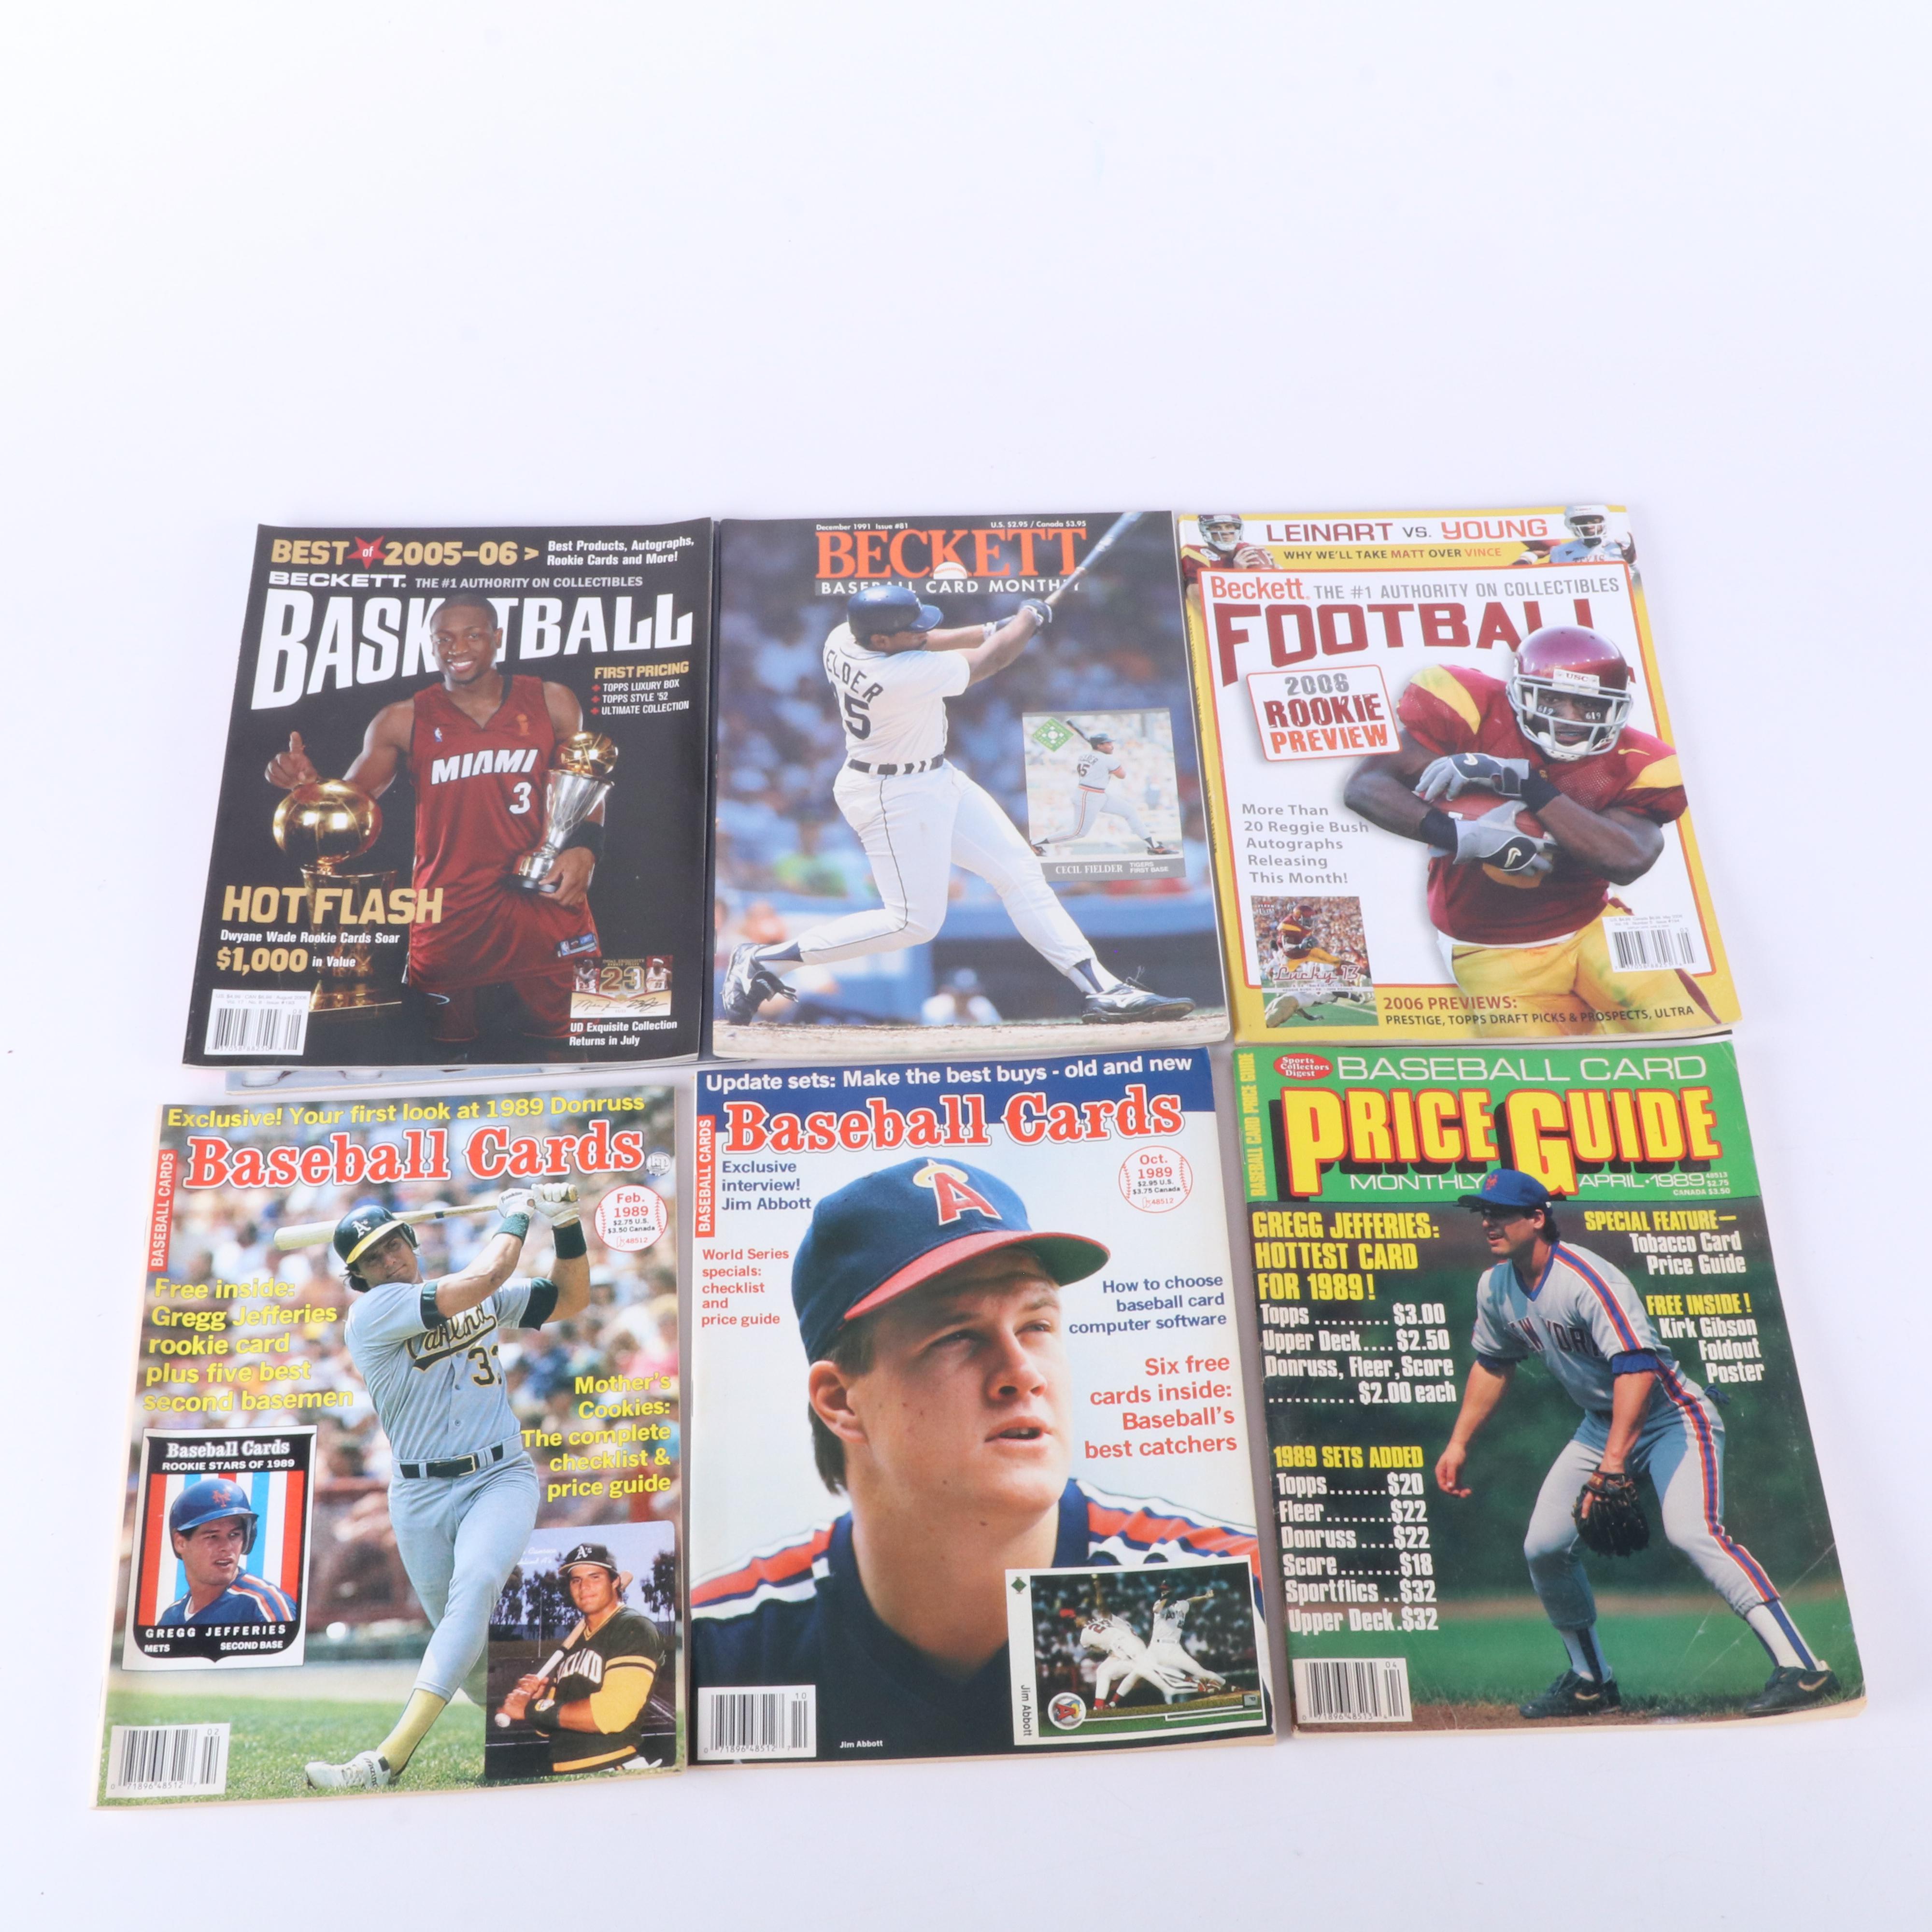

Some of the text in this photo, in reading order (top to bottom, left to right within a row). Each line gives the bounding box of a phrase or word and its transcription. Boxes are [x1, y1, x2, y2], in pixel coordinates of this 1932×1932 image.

[1266, 523, 1393, 543] LEINART
[1441, 518, 1548, 539] YOUNG
[270, 539, 349, 564] BEST
[362, 546, 373, 558] of
[548, 536, 694, 552] Best Products, Autographs,
[816, 528, 1087, 579] BECKETT
[1283, 551, 1314, 560] WHY
[1356, 550, 1388, 559] TAKE
[1391, 549, 1425, 559] MATT
[1428, 548, 1462, 558] OVER
[1464, 547, 1501, 557] VINCE
[547, 552, 678, 567] Rookie Cards and More!
[925, 579, 1079, 594] CARD MONTH
[251, 588, 693, 710] BASKTBALL
[594, 661, 689, 679] FIRST PRICING
[1566, 673, 1588, 682] USC
[603, 679, 680, 693] TOPPS LUXURY BOX
[1284, 673, 1350, 696] 2006
[1264, 693, 1384, 728] ROOKIE
[1270, 723, 1388, 754] PREVIEW
[431, 749, 538, 785] MIAMI
[509, 781, 532, 814] 3
[1243, 821, 1369, 836] 20 Reggie Bush
[1246, 838, 1344, 852] Autographs
[1055, 865, 1122, 874] CECIL FIELDER
[222, 886, 444, 925] HOT FLASH
[216, 947, 356, 975] $1,000 in Value
[1383, 997, 1518, 1010] 2006 PREVIEWS:
[570, 1020, 677, 1034] UD Exquisite Collection
[1385, 1006, 1694, 1027] PRESTIGE, TOPPS DRAFT PICKS & PROSPECTS, ULTRA
[706, 1074, 783, 1094] Update
[787, 1071, 837, 1089] sets:
[842, 1068, 901, 1089] Make
[906, 1067, 941, 1087] the
[946, 1065, 992, 1085] best
[997, 1065, 1048, 1086] buys
[1065, 1060, 1096, 1078] old
[1102, 1056, 1144, 1076] and
[1149, 1057, 1193, 1075] new
[1337, 1056, 1706, 1080] BASEBALL CARD
[168, 1095, 645, 1128] Exclusive! Your first look at 1989 Donruss
[722, 1083, 1185, 1154] Baseball Cards
[1281, 1085, 1723, 1197] PRICE GUIDE
[183, 1120, 645, 1189] Baseball Cards
[1139, 1154, 1168, 1165] Oct.
[722, 1160, 797, 1174] Exclusive
[1137, 1165, 1173, 1179] 1989
[722, 1178, 801, 1193] interview!
[1350, 1174, 1486, 1190] MONTHLY
[1708, 1187, 1730, 1195] $3.50
[617, 1193, 644, 1204] Feb.
[151, 1154, 174, 1268] BASEBALL CARDS
[614, 1206, 649, 1218] 1989
[1252, 1212, 1441, 1240] GREGG JEFFERIES:
[1631, 1232, 1742, 1253] Tobacco Card
[702, 1248, 789, 1261] World Series
[1254, 1242, 1419, 1270] HOTTEST CARD
[1646, 1253, 1747, 1276] Price Guide
[151, 1303, 338, 1331] Gregg Jefferies
[1069, 1311, 1227, 1336] computer software
[1659, 1317, 1757, 1338] Kirk Gibson
[1699, 1338, 1761, 1360] Foldout
[1706, 1361, 1765, 1383] Poster
[1084, 1434, 1237, 1459] best catchers
[1273, 1445, 1424, 1468] 1989 SETS ADDED
[162, 1459, 295, 1471] ROOKIE STARS OF 1989
[549, 1447, 671, 1473] checklist &
[146, 1624, 286, 1638] GREGG JEFFERIES
[1021, 1685, 1033, 1737] Jim Abbott
[839, 1739, 883, 1749] Jim Abbott
